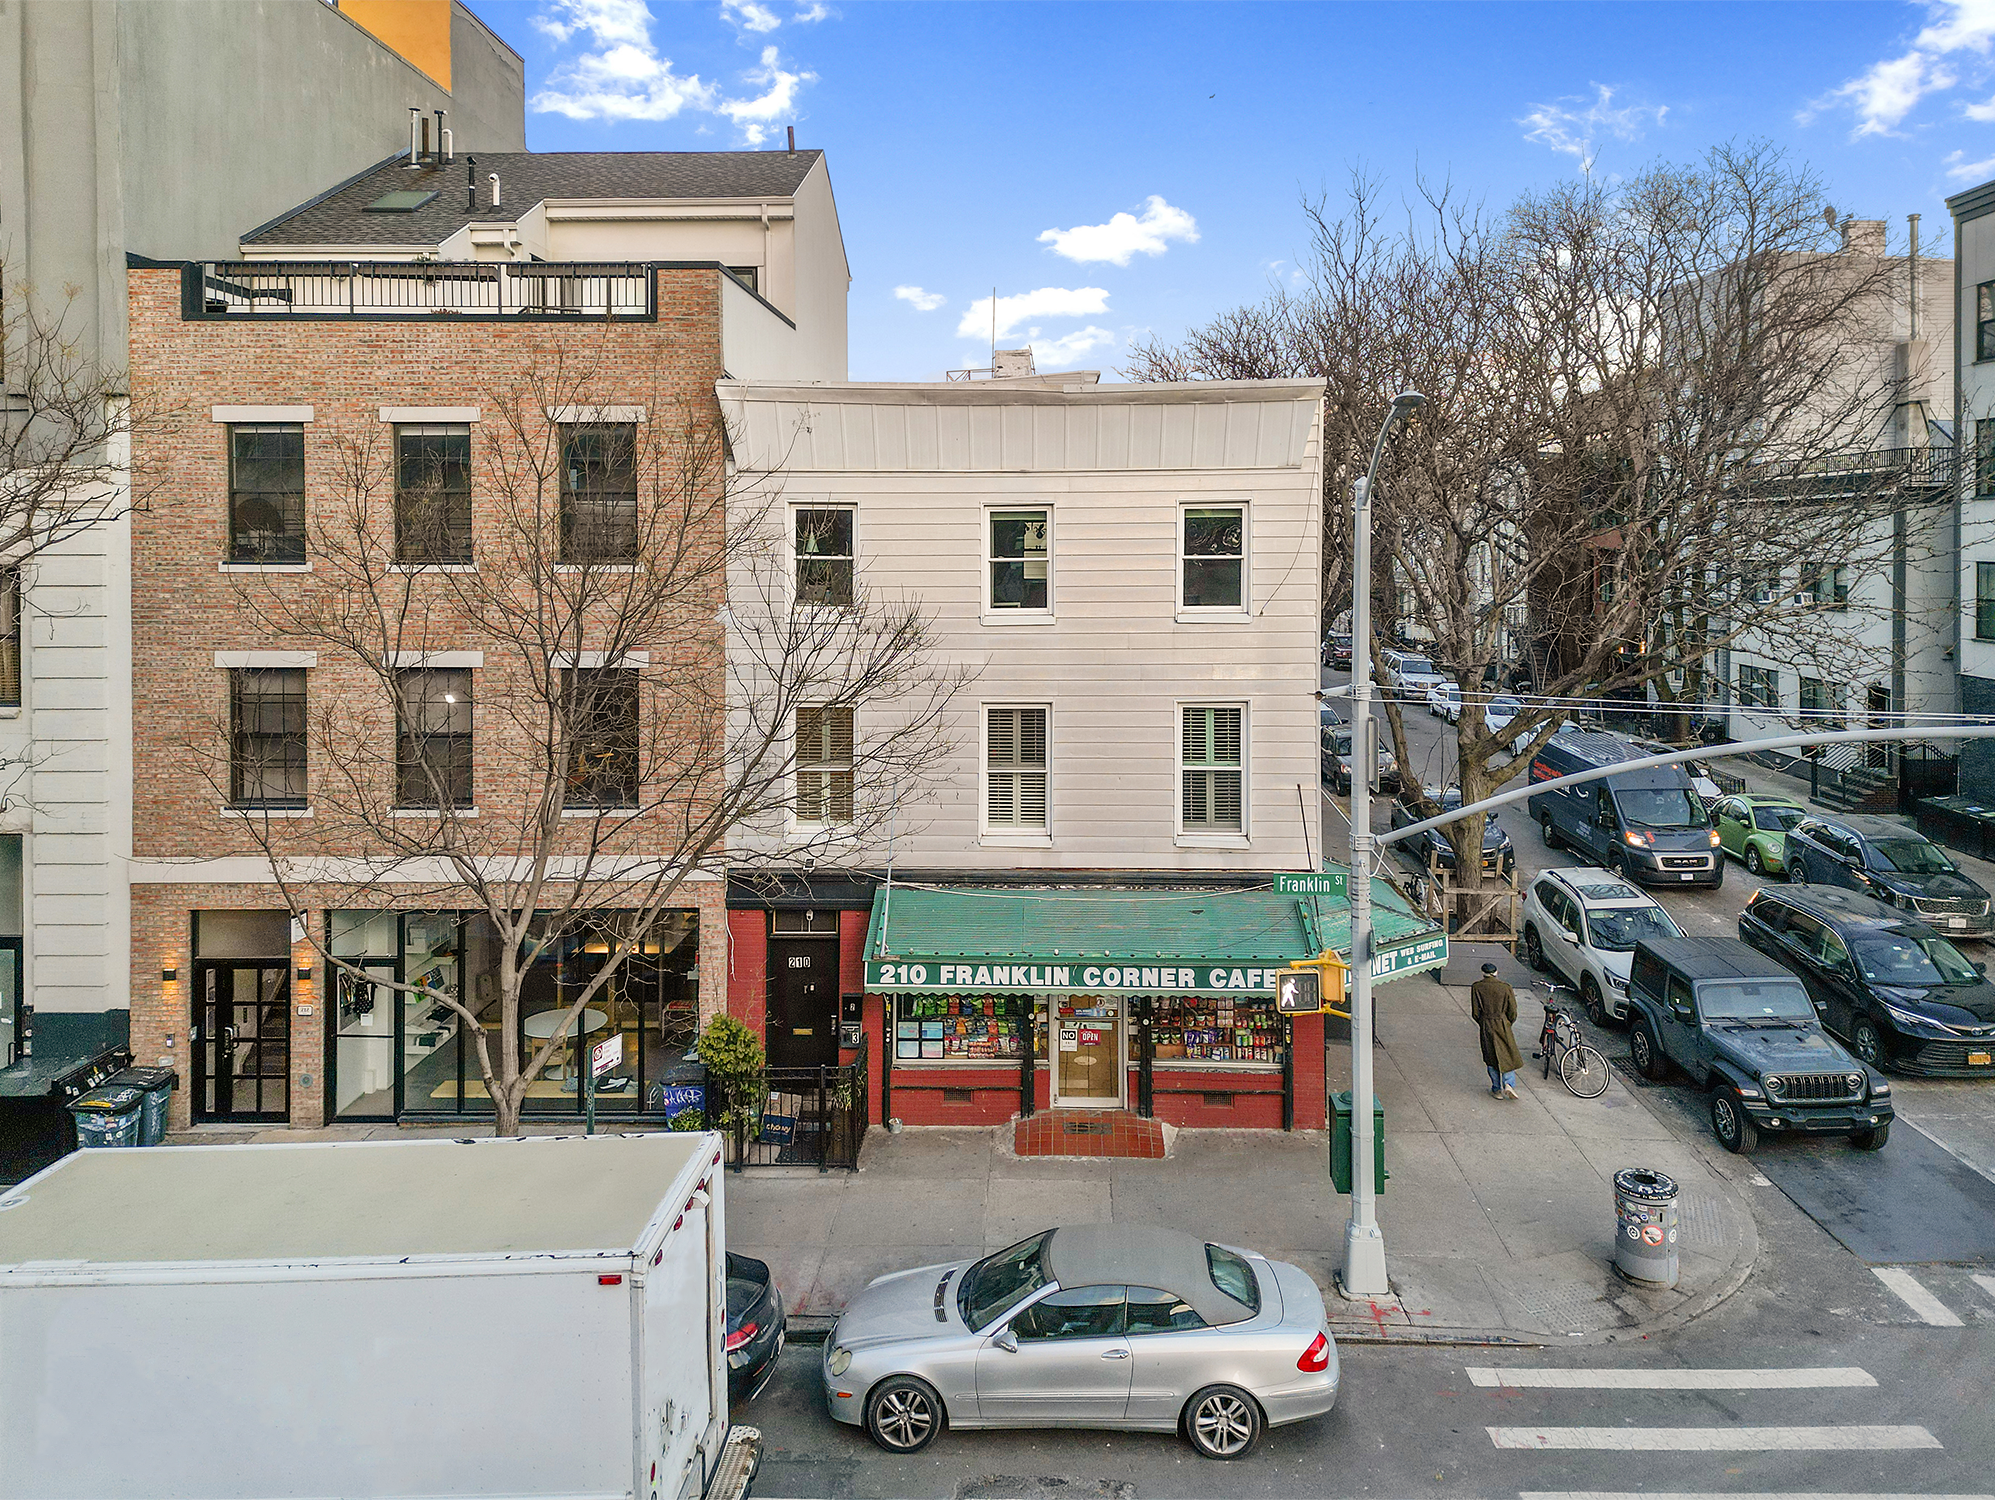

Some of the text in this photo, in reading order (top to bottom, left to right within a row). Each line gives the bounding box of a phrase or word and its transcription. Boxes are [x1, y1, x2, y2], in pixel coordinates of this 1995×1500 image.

[1279, 875, 1343, 892] Franklin St
[1400, 939, 1443, 957] WEB SURFING
[788, 957, 811, 968] 210
[1414, 951, 1436, 963] E-MAIL
[879, 964, 1276, 988] 210 FRANKLIN CORNER CAFE
[853, 1033, 858, 1043] 3
[1062, 1031, 1075, 1040] NO
[1082, 1033, 1099, 1041] OPEN
